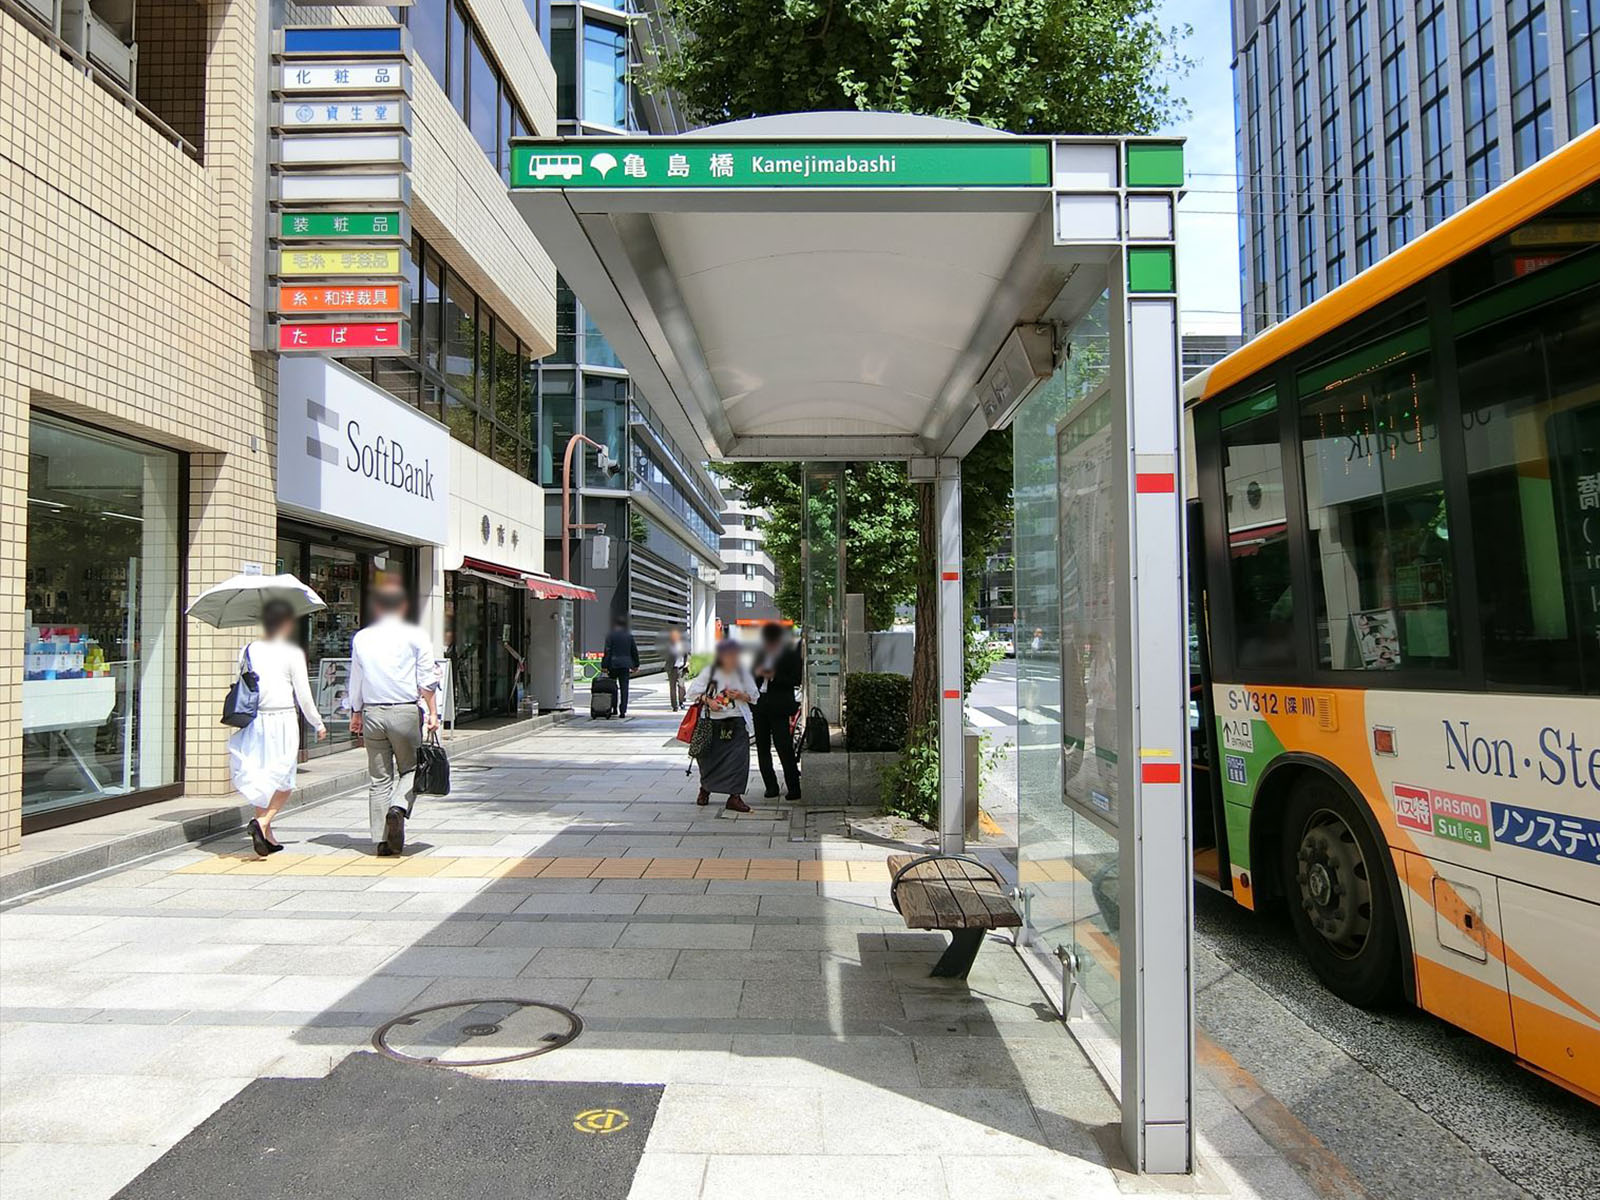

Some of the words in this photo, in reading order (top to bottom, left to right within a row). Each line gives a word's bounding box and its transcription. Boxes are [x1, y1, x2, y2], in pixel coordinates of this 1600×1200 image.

[296, 68, 390, 84] 化粧品
[326, 104, 387, 121] 資生堂
[623, 152, 734, 178] 亀島橋
[751, 155, 896, 177] Kamejimabashi
[292, 216, 388, 232] 装粧品
[293, 289, 388, 306] 糸・和洋裁具
[292, 327, 388, 344] たばこ
[346, 420, 434, 501] SoftBank
[1228, 690, 1278, 714] S-V312
[1233, 720, 1249, 736] 入口
[1434, 795, 1481, 819] PASMO
[1438, 818, 1483, 844] Suica
